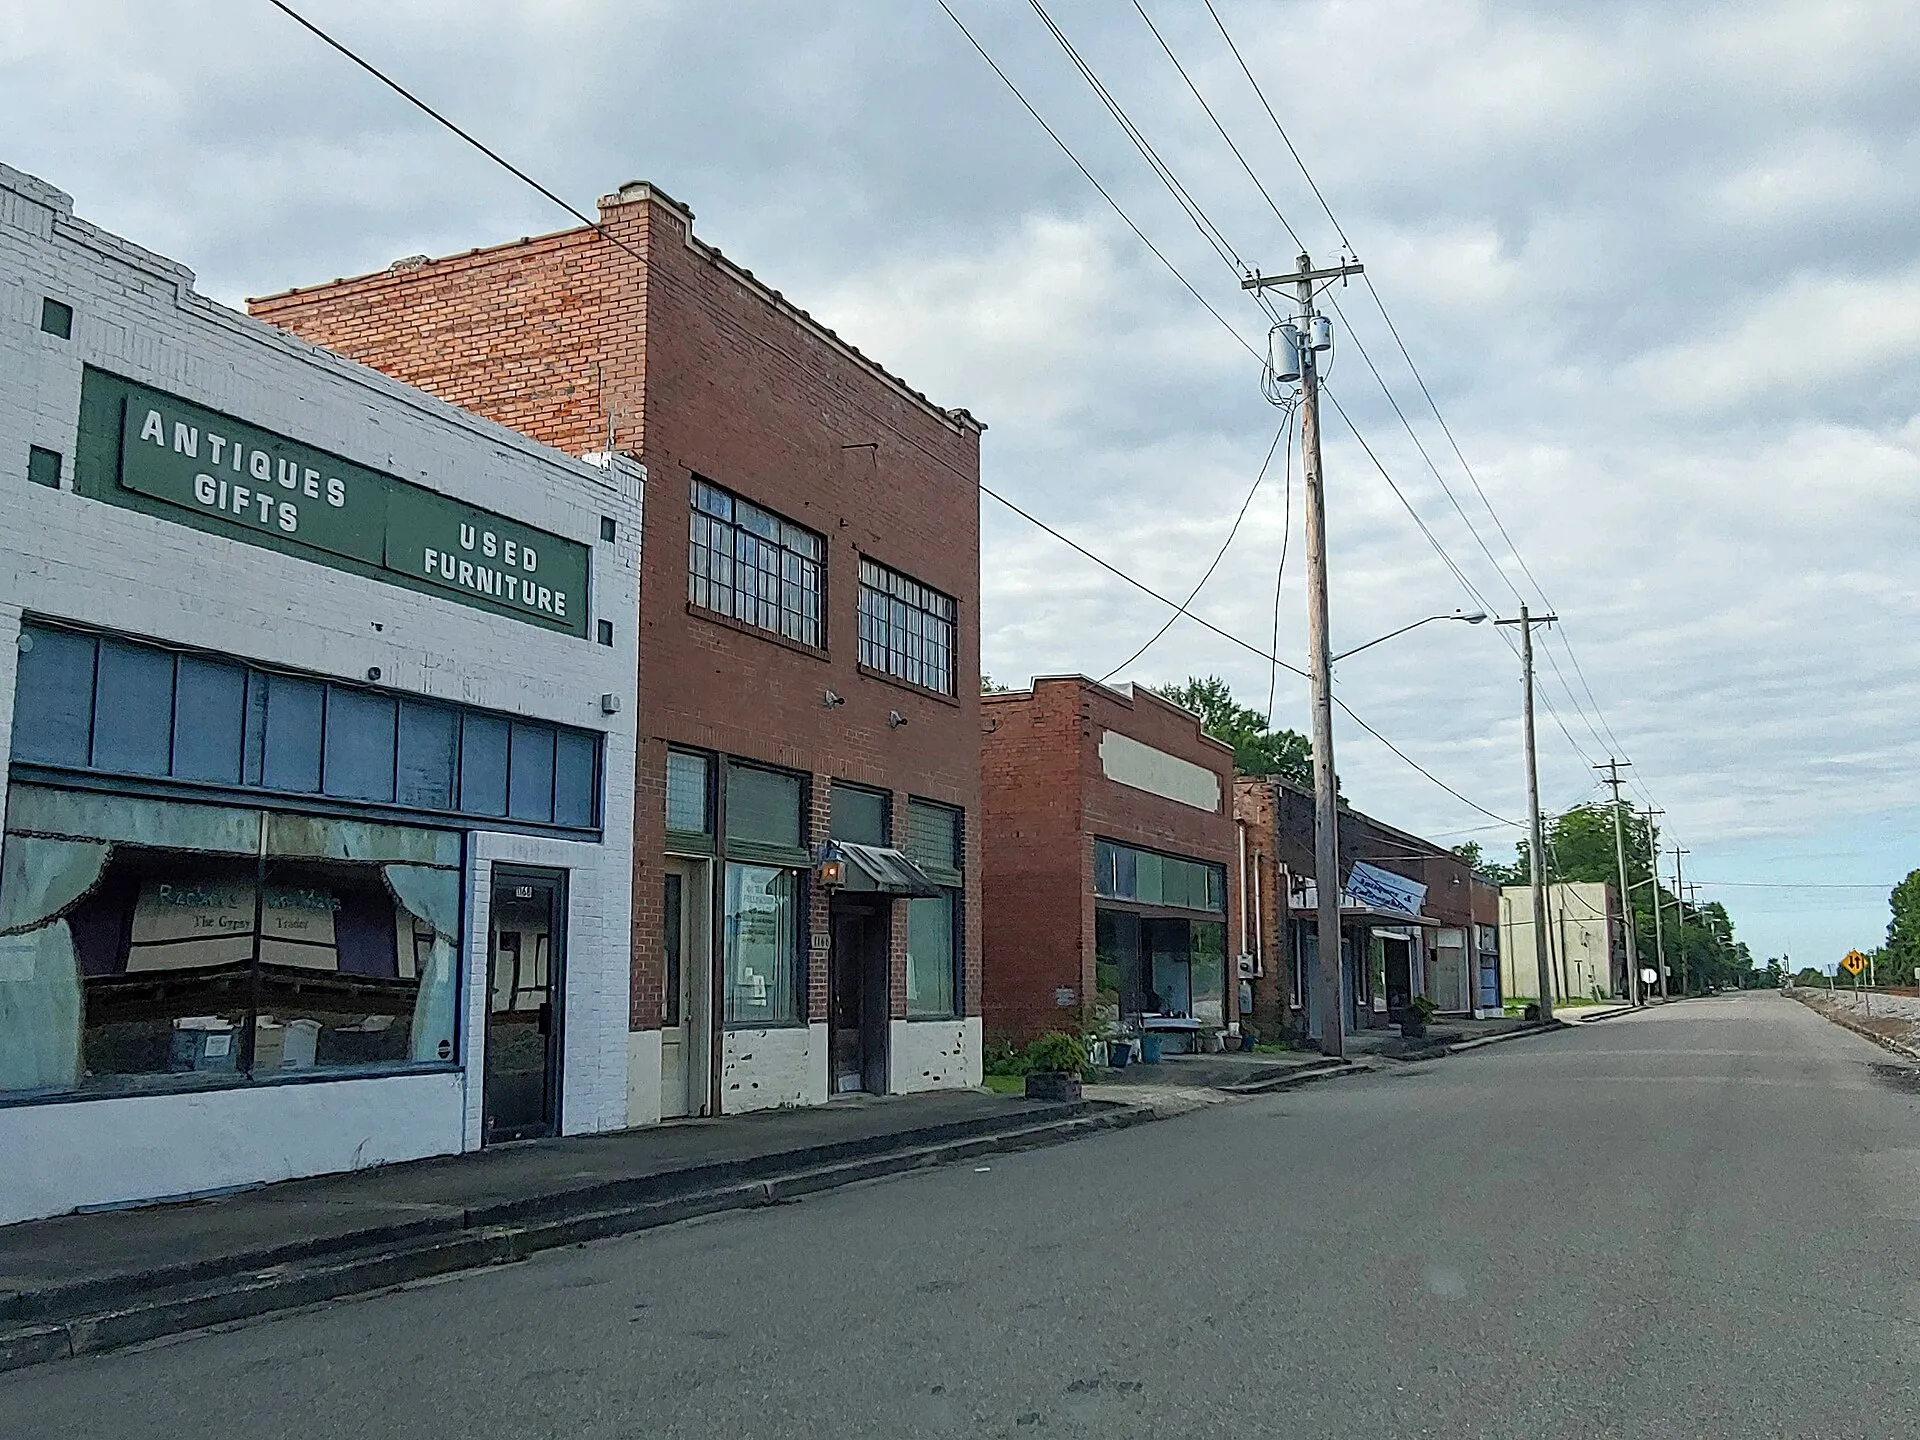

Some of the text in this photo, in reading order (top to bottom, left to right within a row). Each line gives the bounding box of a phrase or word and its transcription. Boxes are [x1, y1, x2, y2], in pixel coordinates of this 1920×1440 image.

[140, 408, 347, 508] ANTIQUES
[194, 472, 299, 532] GIFTS
[458, 522, 538, 573] USED
[424, 547, 566, 617] FURNITURE
